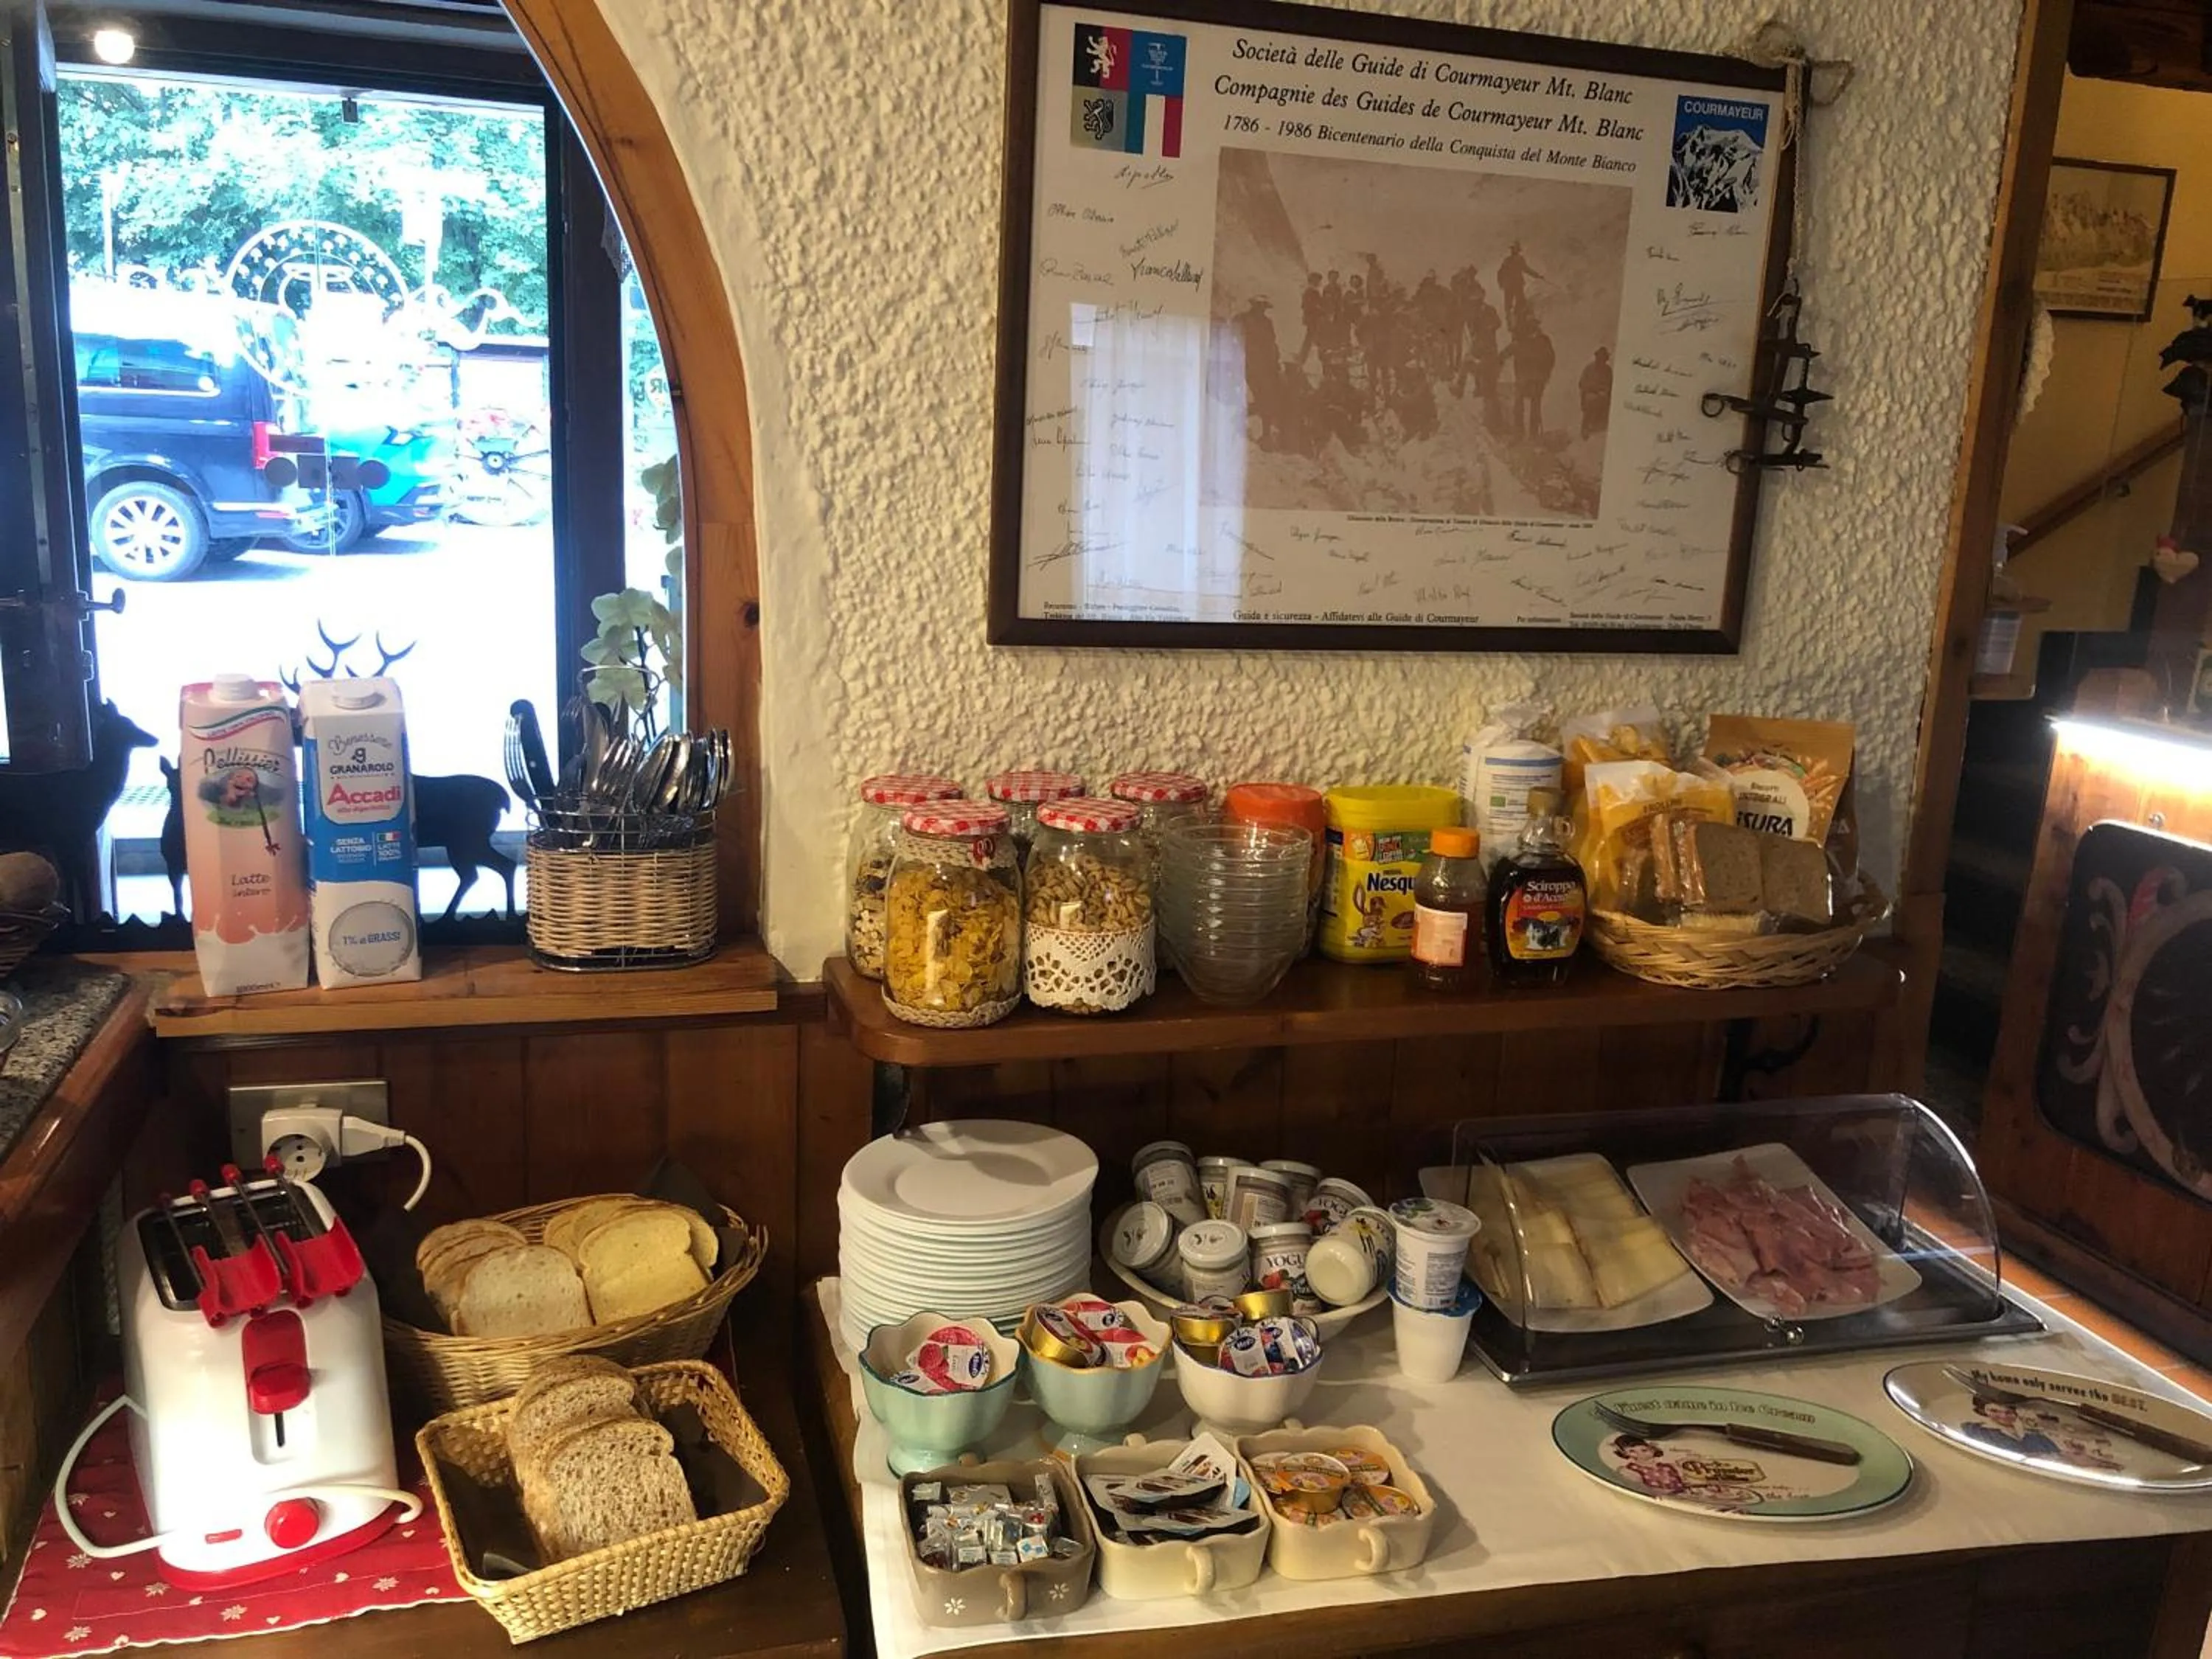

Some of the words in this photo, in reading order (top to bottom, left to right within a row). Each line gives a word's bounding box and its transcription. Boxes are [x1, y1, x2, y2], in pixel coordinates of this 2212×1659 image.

[1232, 38, 1297, 64] Società
[1304, 47, 1344, 70] delle
[1352, 52, 1404, 77] Guide
[1409, 60, 1429, 80] di
[1435, 63, 1540, 94] Courmayeur
[1545, 76, 1576, 98] Mt.
[1584, 80, 1633, 104] Blanc
[1214, 74, 1316, 107] Compagnie
[1321, 87, 1348, 108] des
[1356, 91, 1415, 116] Guides
[1421, 98, 1441, 118] de
[1448, 101, 1553, 132] Courmayeur
[1557, 114, 1587, 135] Mt.
[1596, 118, 1644, 141] Blanc
[1683, 100, 1764, 122] COURMAYEUR
[1223, 114, 1259, 133] 1786
[1277, 119, 1312, 139] 1986
[1318, 124, 1405, 150] Bicentenario
[1409, 135, 1444, 153] della
[1450, 139, 1516, 161] Conquista
[1520, 147, 1543, 163] del
[1546, 150, 1587, 168] Monte
[1592, 153, 1637, 173] Bianco
[330, 762, 394, 775] GRANAROLO
[232, 873, 271, 886] Latte
[1366, 872, 1416, 896] Nesqu
[1989, 1371, 2020, 1385] home
[2023, 1377, 2045, 1392] only
[2048, 1382, 2086, 1397] serves
[2089, 1388, 2109, 1402] the
